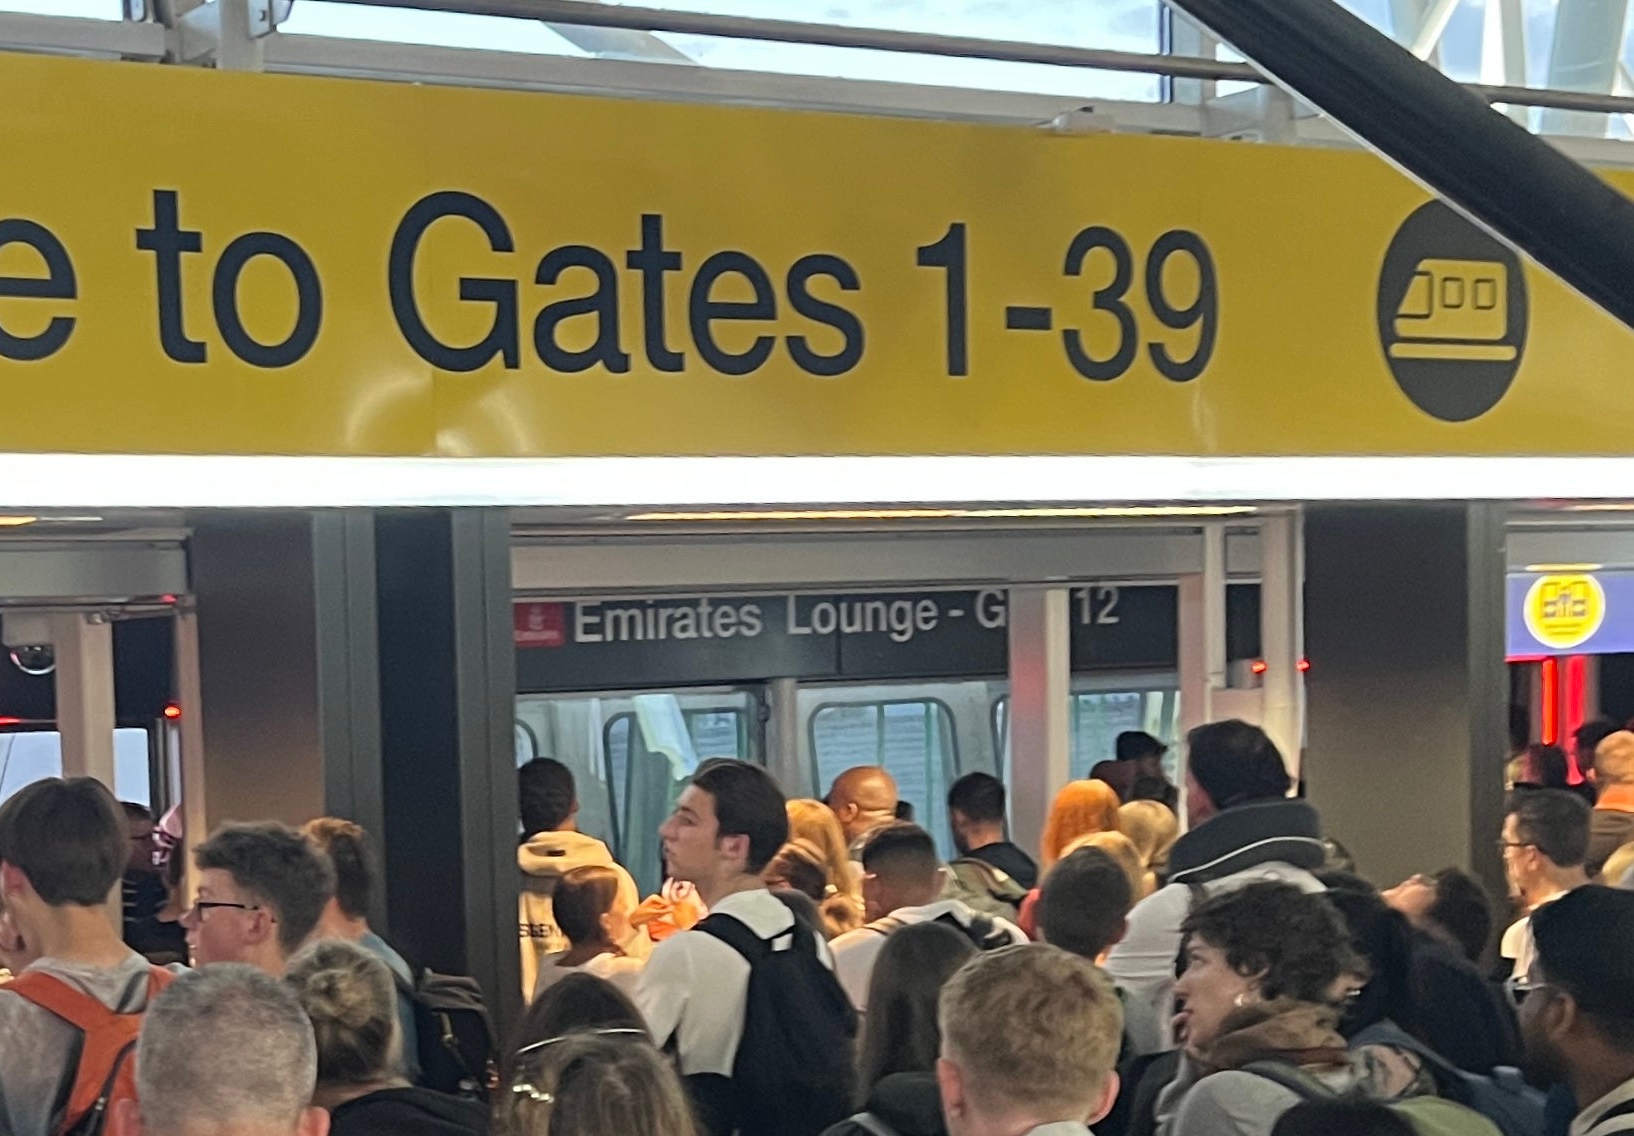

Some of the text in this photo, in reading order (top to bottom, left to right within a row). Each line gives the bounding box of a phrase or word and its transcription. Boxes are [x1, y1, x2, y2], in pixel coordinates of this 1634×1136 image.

[134, 188, 324, 369] to
[387, 190, 866, 377] Gates
[915, 221, 1219, 382] 1-39
[573, 597, 763, 643] Emirates
[786, 593, 939, 643] Lounge
[1073, 586, 1121, 626] 12
